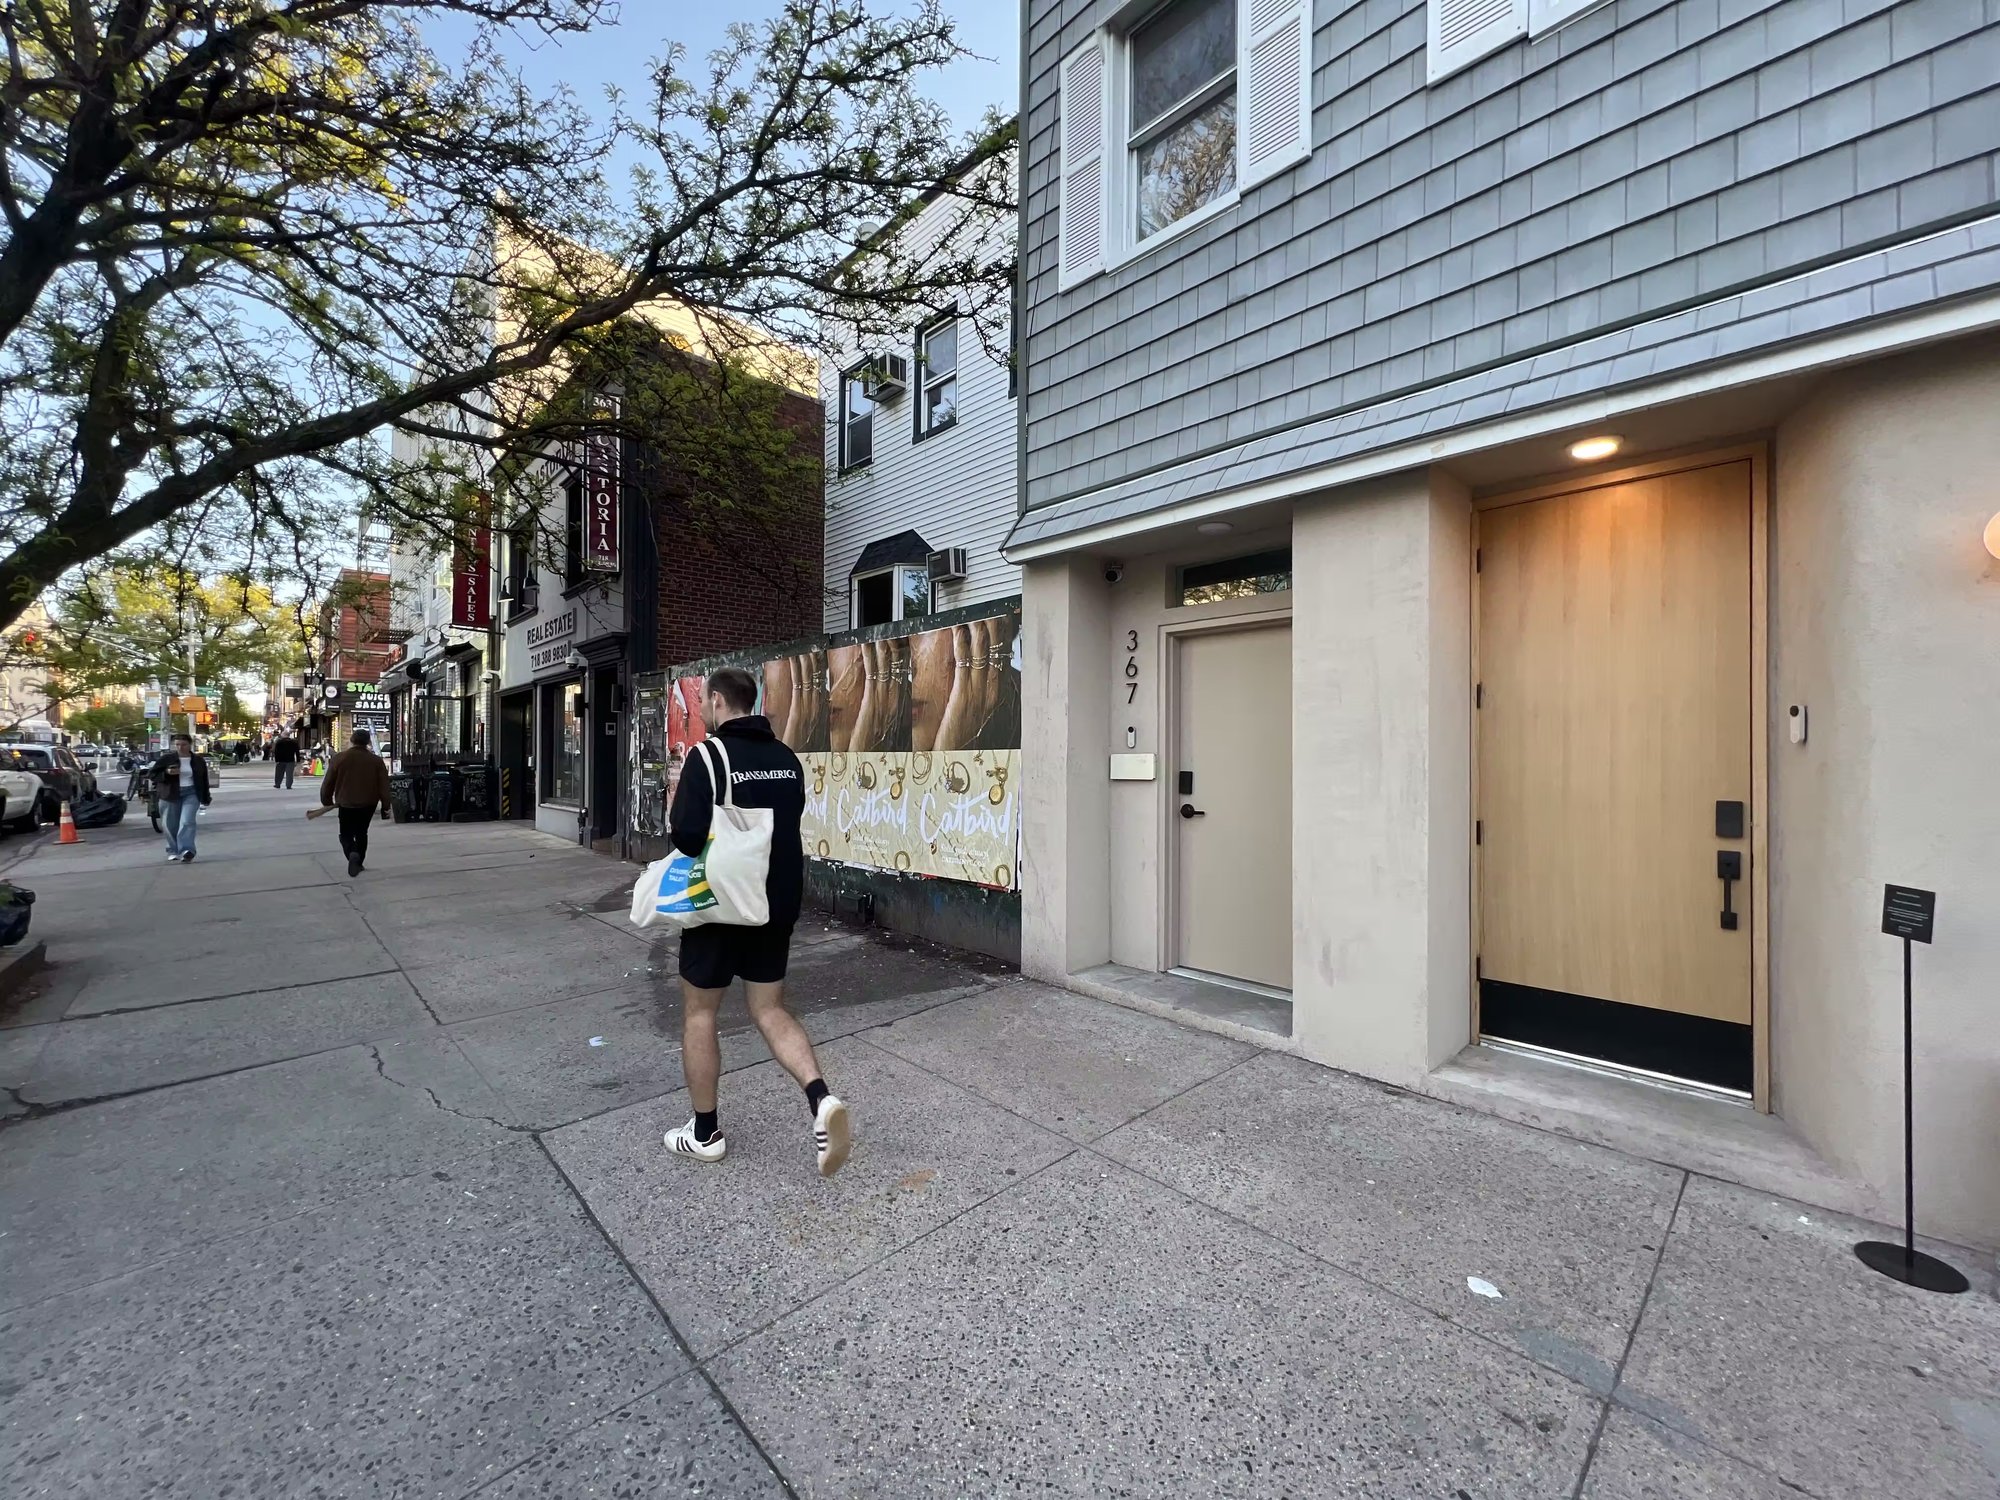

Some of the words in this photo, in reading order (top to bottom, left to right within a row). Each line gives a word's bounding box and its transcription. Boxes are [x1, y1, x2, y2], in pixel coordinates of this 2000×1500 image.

[592, 396, 612, 408] 363
[467, 577, 476, 621] SALES
[527, 624, 543, 645] REAL
[544, 611, 572, 638] ESTATE
[531, 653, 541, 668] 718
[1125, 629, 1138, 704] 367
[730, 769, 797, 785] TRANSAMERICA
[836, 784, 909, 835] Catbird
[920, 791, 1012, 846] Catbird
